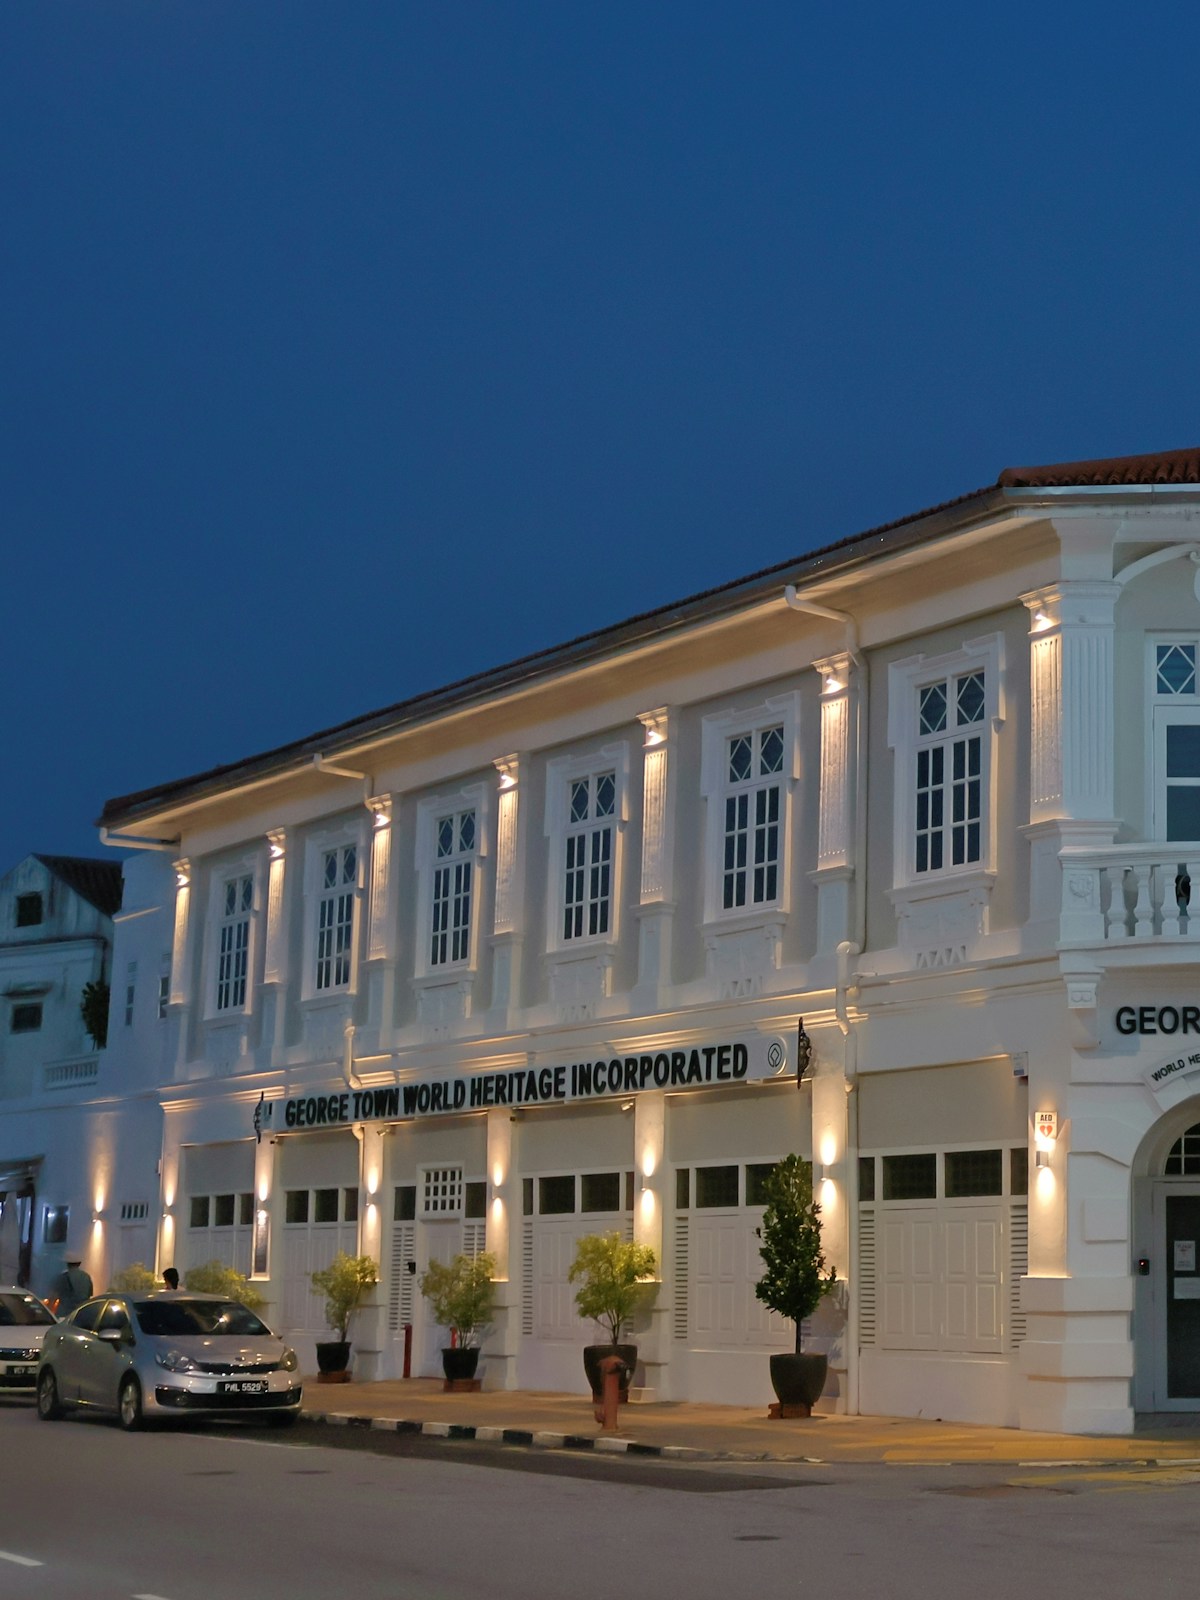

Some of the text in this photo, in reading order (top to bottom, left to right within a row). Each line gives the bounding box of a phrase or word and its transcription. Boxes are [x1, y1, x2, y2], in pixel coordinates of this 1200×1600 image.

[1151, 1059, 1186, 1082] WORLD
[285, 1043, 749, 1127] GEORGE TOWN WORLD HERITAGE INCORPORATED
[242, 1382, 261, 1391] 5529
